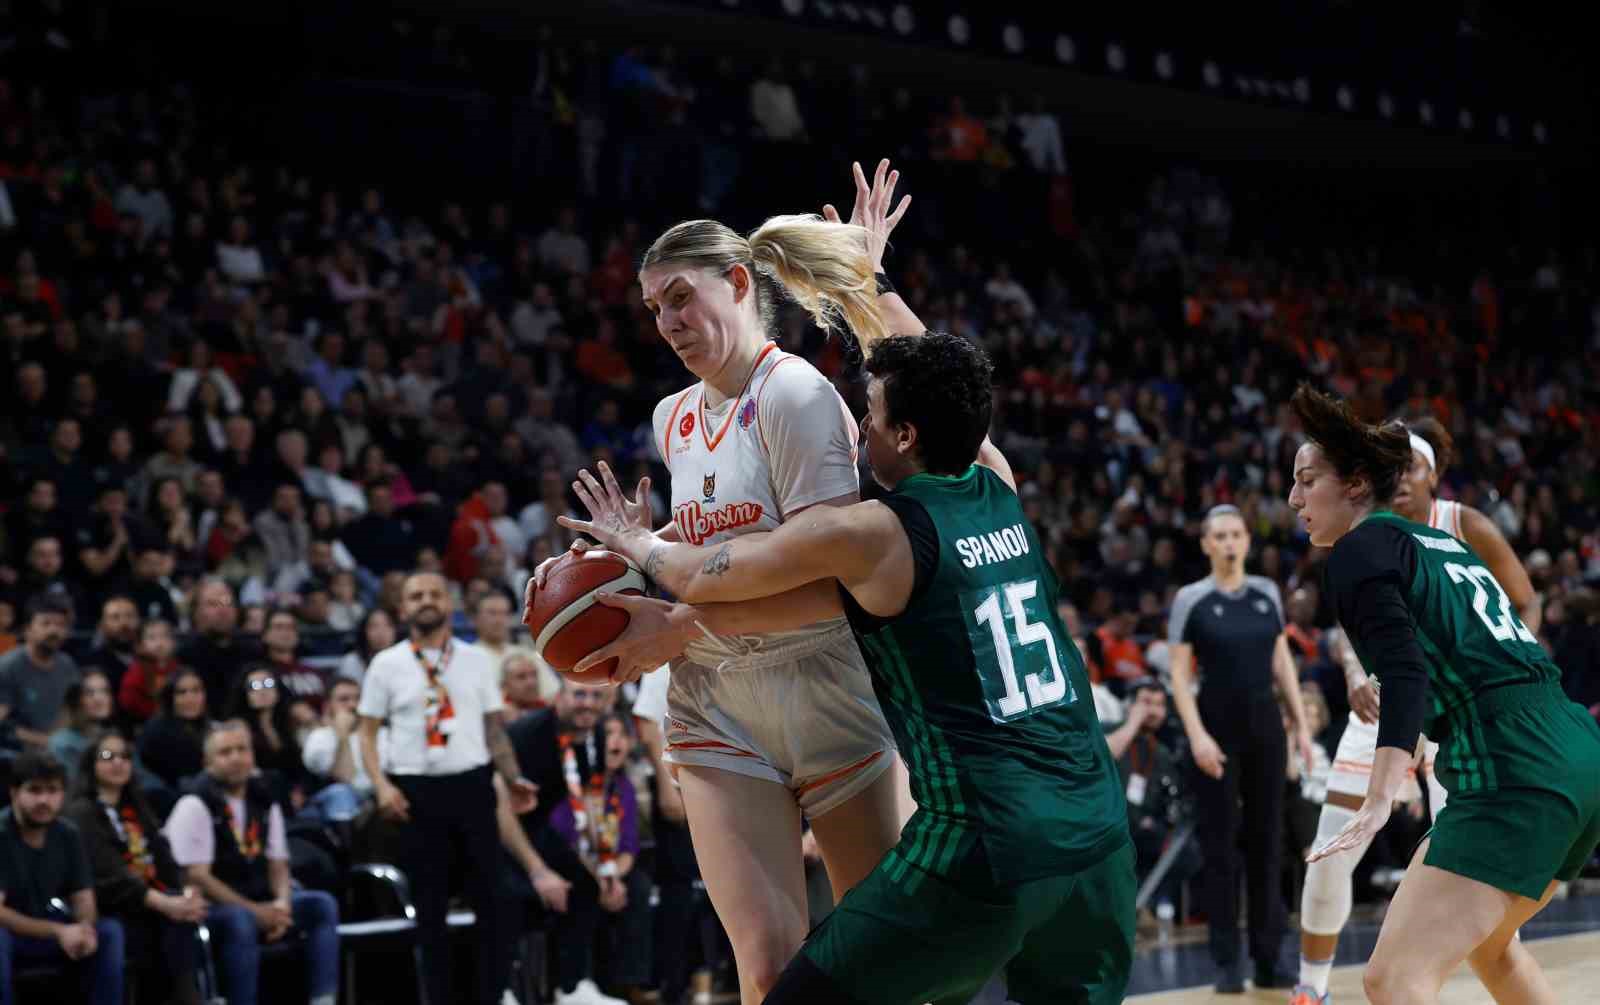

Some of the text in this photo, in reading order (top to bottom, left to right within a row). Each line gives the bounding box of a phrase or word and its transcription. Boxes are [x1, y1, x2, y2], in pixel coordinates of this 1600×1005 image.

[673, 500, 764, 546] Mersin
[955, 523, 1029, 569] SPANOU
[1443, 561, 1538, 643] 22
[974, 580, 1067, 717] 15
